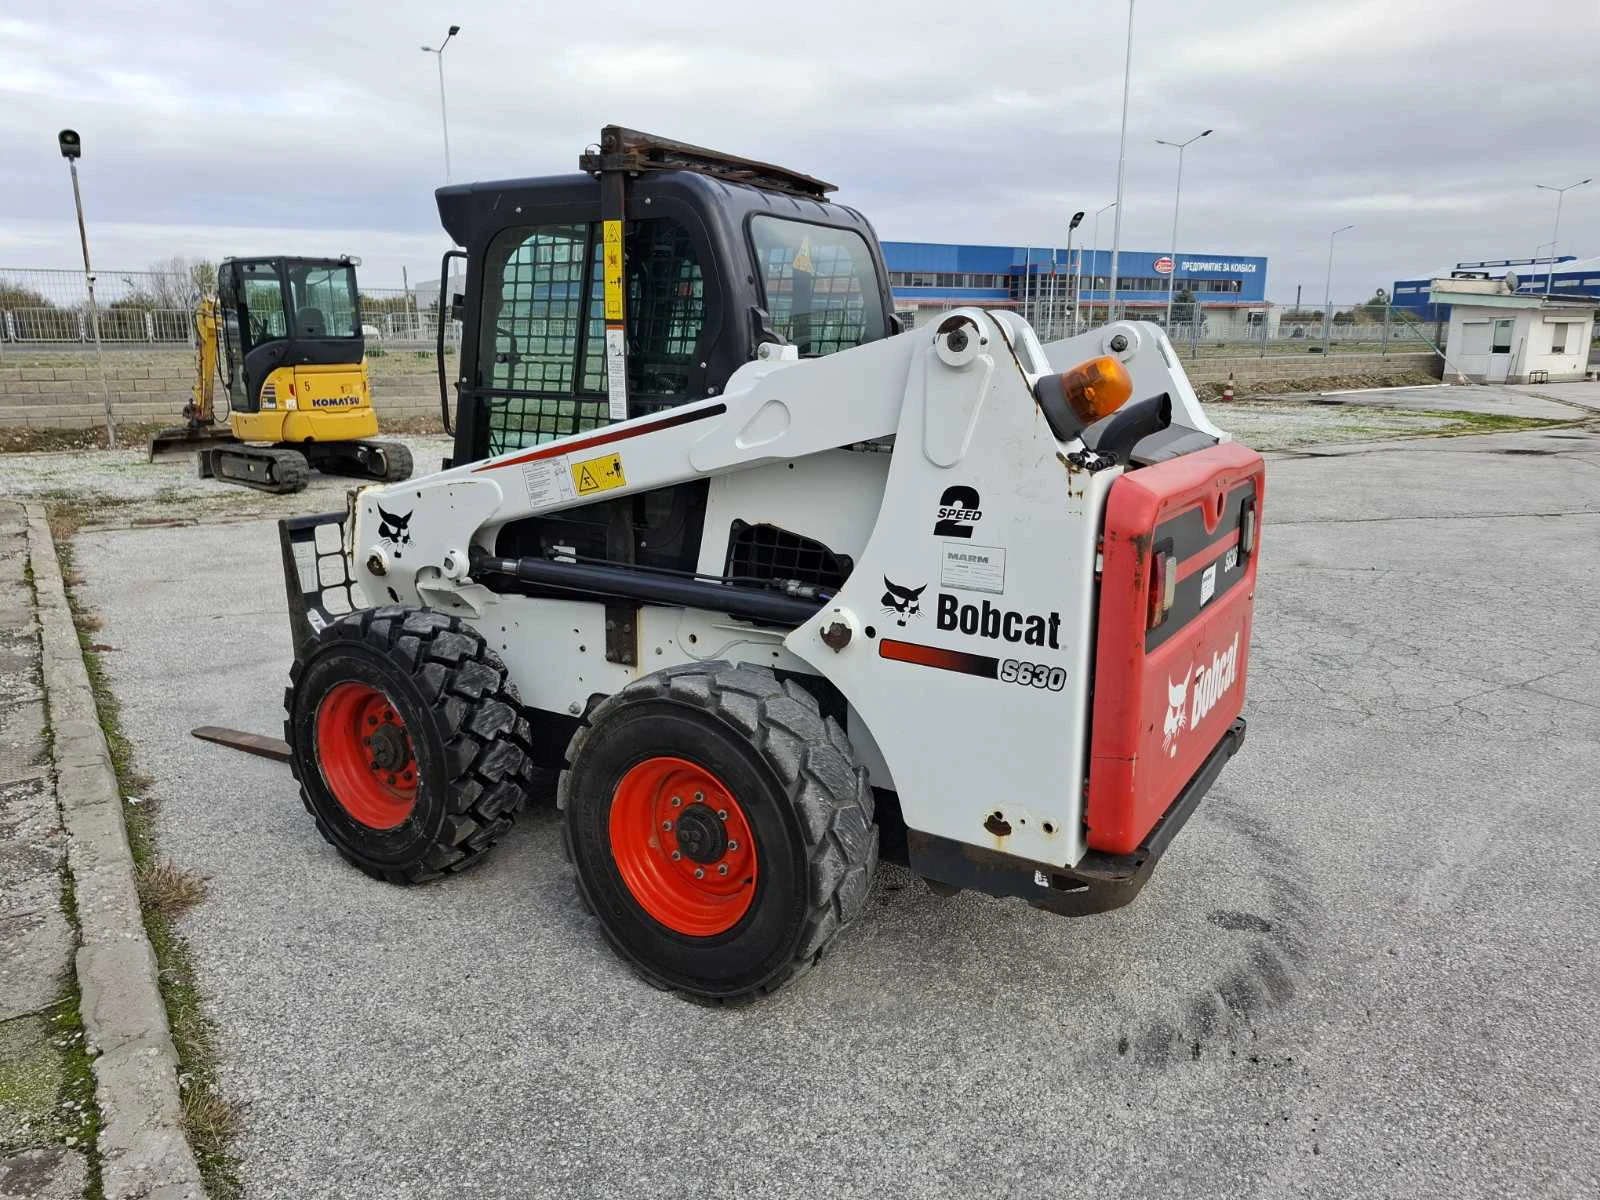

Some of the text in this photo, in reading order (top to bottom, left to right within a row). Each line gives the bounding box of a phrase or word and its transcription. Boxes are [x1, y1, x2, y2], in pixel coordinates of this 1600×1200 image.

[1181, 261, 1222, 272] ПРЕДПРИЯТИЕ
[1223, 263, 1230, 272] ЗА
[1231, 263, 1257, 273] КОЛБАСИ
[312, 396, 360, 407] KOMATSU
[933, 485, 980, 538] 2
[937, 507, 982, 521] SPEED
[947, 552, 989, 564] MARM
[937, 593, 1061, 650] Bobcat
[1000, 658, 1067, 692] S630
[1190, 632, 1239, 731] Bobcat
